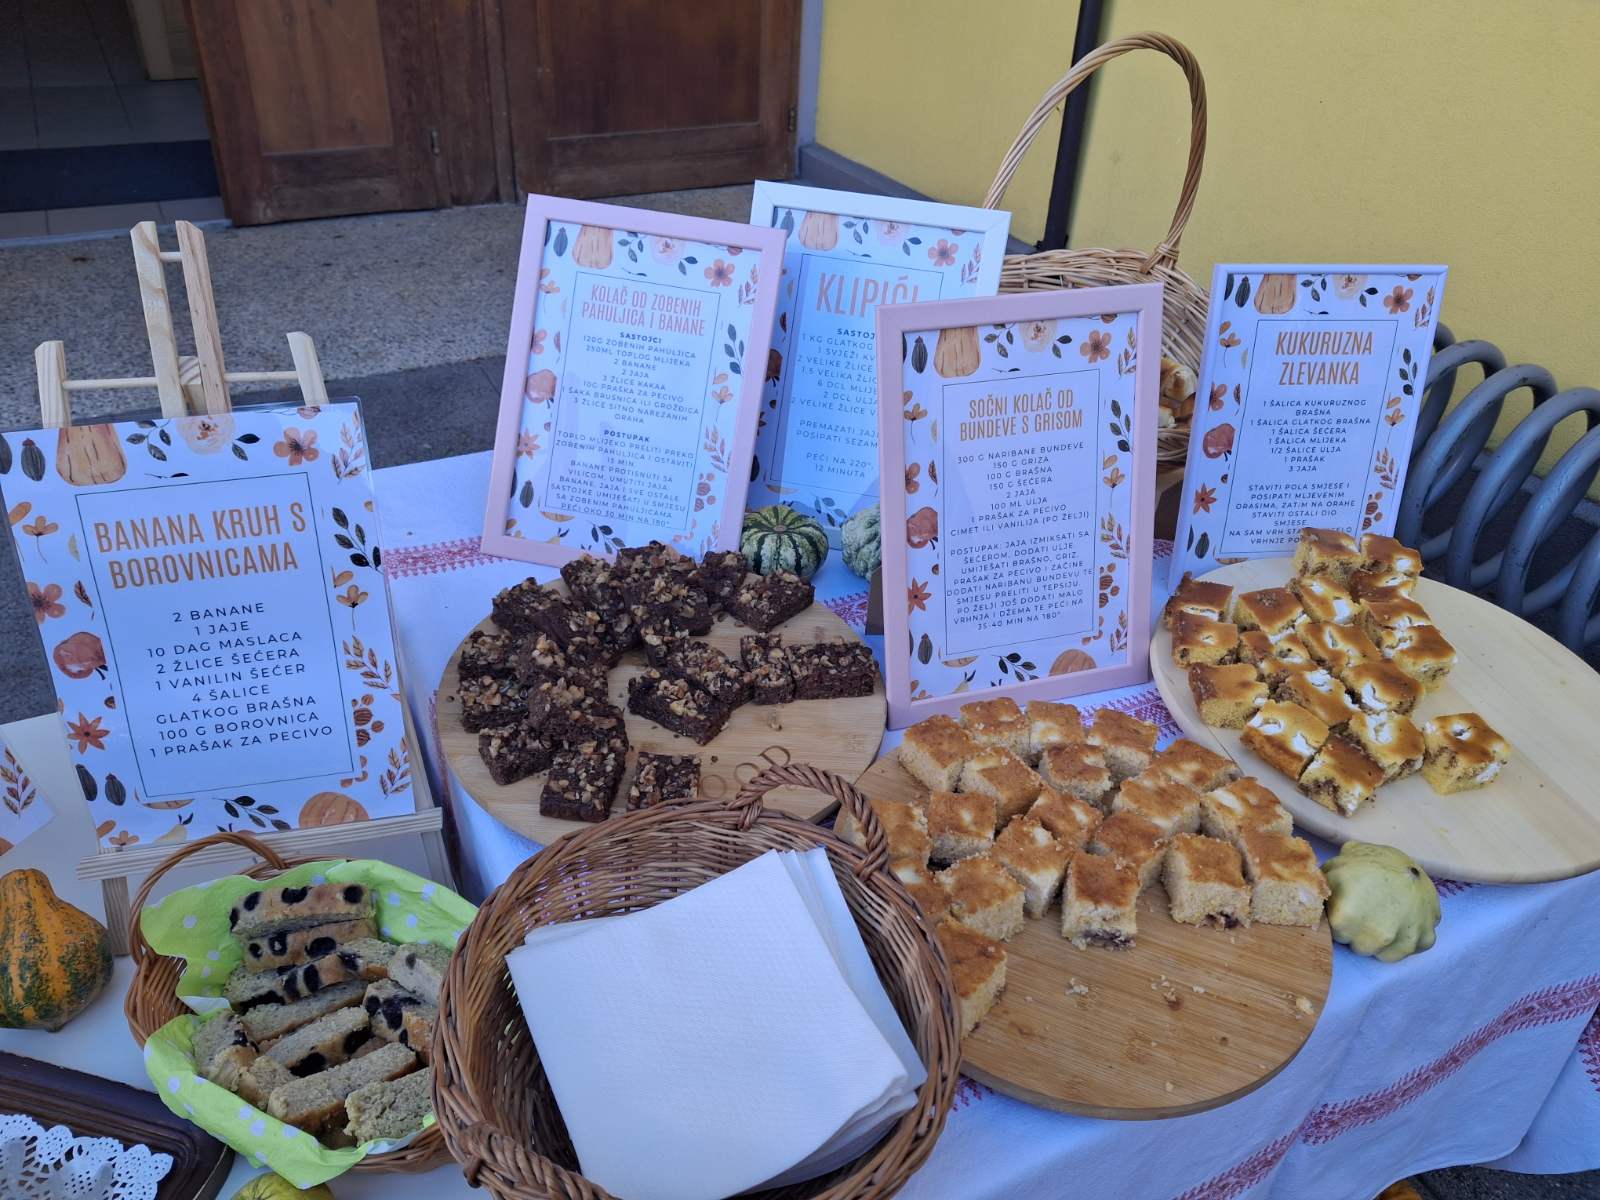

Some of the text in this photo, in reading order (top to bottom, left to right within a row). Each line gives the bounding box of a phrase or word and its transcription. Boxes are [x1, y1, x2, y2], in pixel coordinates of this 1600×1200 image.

[590, 284, 701, 317] KOLAČ OD ZOBENIH
[581, 301, 706, 336] PAHULJICA I BANANE
[836, 327, 875, 340] SASTOJ
[1275, 331, 1373, 356] KUKURUZNA
[1278, 361, 1359, 386] ZLEVANKA
[969, 386, 1073, 419] SOČNI KOLAČ OD
[1304, 398, 1367, 407] KUKURUZNOG
[960, 408, 1082, 442] BUNDEVE S GRISOM
[1291, 417, 1333, 426] GLATKOG
[1308, 436, 1347, 444] MLIJEKA
[957, 454, 974, 464] 300
[987, 446, 1036, 460] NARIBANE
[1039, 441, 1084, 454] BUNDEVE
[1270, 446, 1283, 455] 1/2
[1319, 444, 1341, 454] ULJA
[992, 460, 1008, 469] 150
[1020, 455, 1049, 466] GRIZA
[1288, 464, 1317, 473] 3 JAJA
[986, 471, 1002, 481] 100
[989, 481, 1004, 491] 150
[1005, 486, 1036, 499] 2 JAJA
[1248, 482, 1282, 492] STAVITI
[1284, 482, 1308, 491] POLA
[1310, 481, 1344, 491] SMJESE
[990, 496, 1048, 511] 100 ML ULJA
[1250, 491, 1345, 501] POSIPATI MLJEVENIM
[1280, 500, 1308, 509] ZATIM
[1325, 499, 1356, 508] ORAHE
[1017, 509, 1030, 517] ZA
[1032, 503, 1067, 515] PECIVO
[1251, 508, 1337, 519] STAVITI OSTALI DIO
[93, 502, 306, 553] BANANA KRUH S
[950, 525, 979, 537] CIMET
[982, 523, 994, 532] ILI
[997, 517, 1039, 530] VANILIJA
[1004, 538, 1027, 549] JAJA
[1029, 531, 1075, 545] IZMIKSATI
[1077, 530, 1090, 538] SA
[1250, 536, 1285, 545] VRHNJE
[1011, 541, 1073, 557] DODATI ULJE
[108, 541, 298, 590] BOROVNICAMA
[1007, 565, 1042, 577] PECIVO
[984, 570, 1080, 591] NARIBANU BUNDEVU
[994, 586, 1029, 599] PRELITI
[172, 602, 264, 622] 2 BANANE
[953, 612, 990, 625] VRHNJA
[193, 620, 250, 636] 1 JAJE
[1005, 616, 1023, 626] MIN
[147, 631, 302, 658] 10 DAG MASLACA
[155, 647, 300, 674] 2 ŽLICE ŠEĆERA
[155, 663, 305, 691] 1 VANILIN ŠEĆER
[191, 684, 270, 703] 4 ŠALICE
[156, 695, 316, 724] GLATKOG BRAŠNA
[159, 711, 319, 741] 100 G BOROVNICA
[149, 725, 332, 757] 1 PRAŠAK ZA PECIVO
